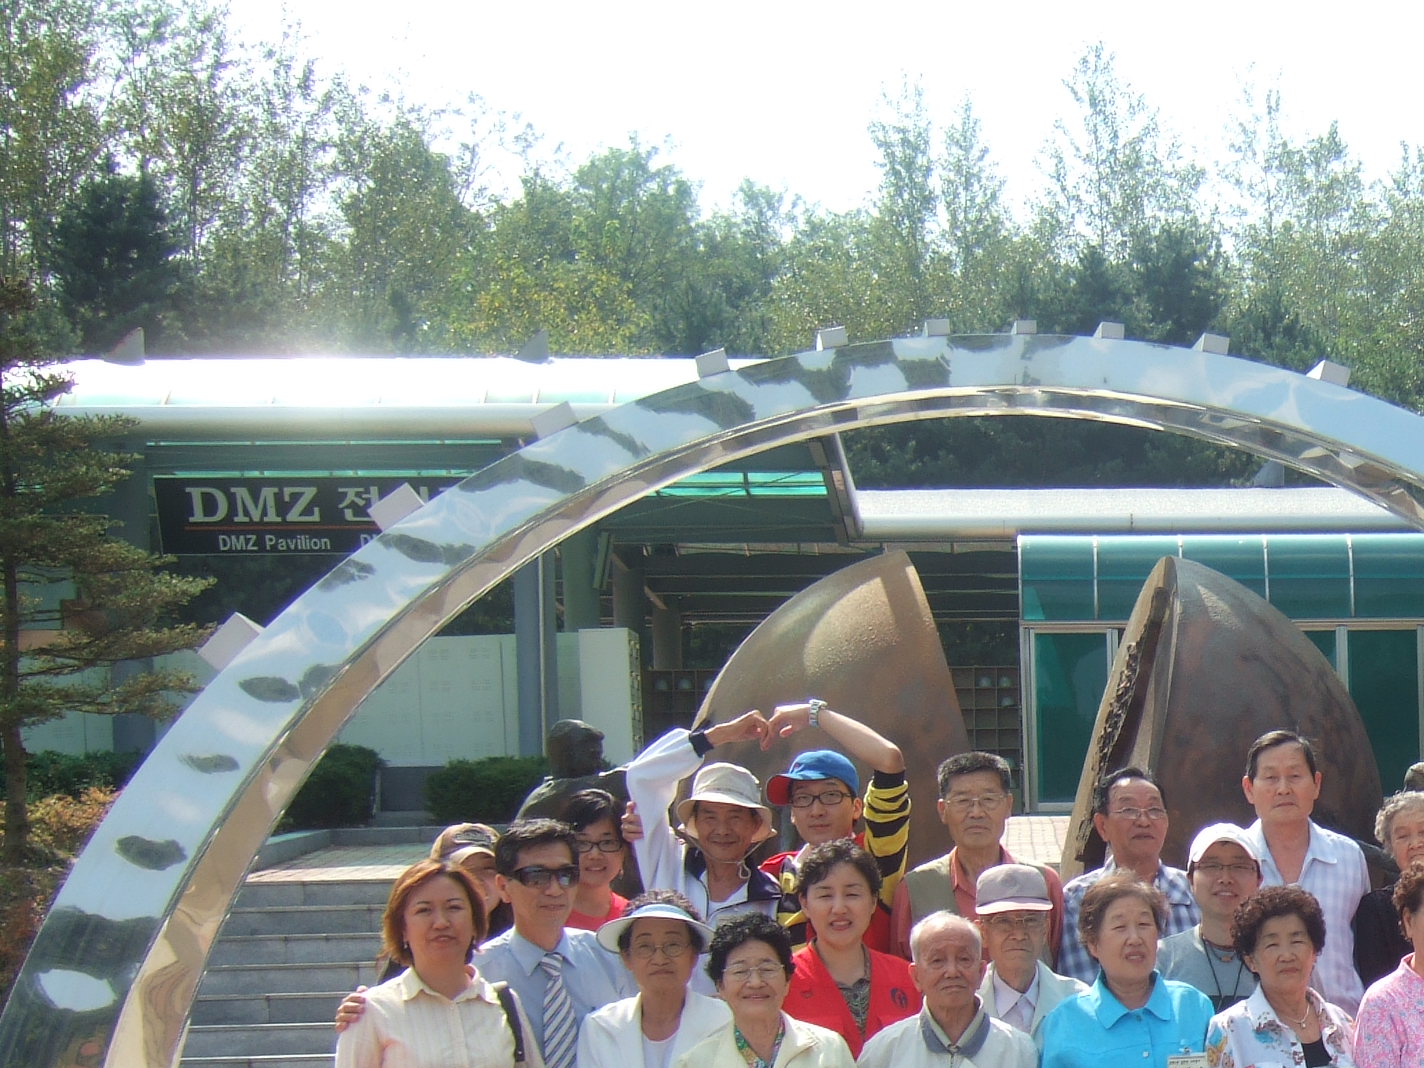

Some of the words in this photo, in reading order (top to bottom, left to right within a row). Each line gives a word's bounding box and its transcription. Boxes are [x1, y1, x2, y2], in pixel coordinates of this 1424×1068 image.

[185, 486, 321, 523] DMZ
[218, 534, 258, 550] DMZ
[266, 534, 331, 550] Pavilion
